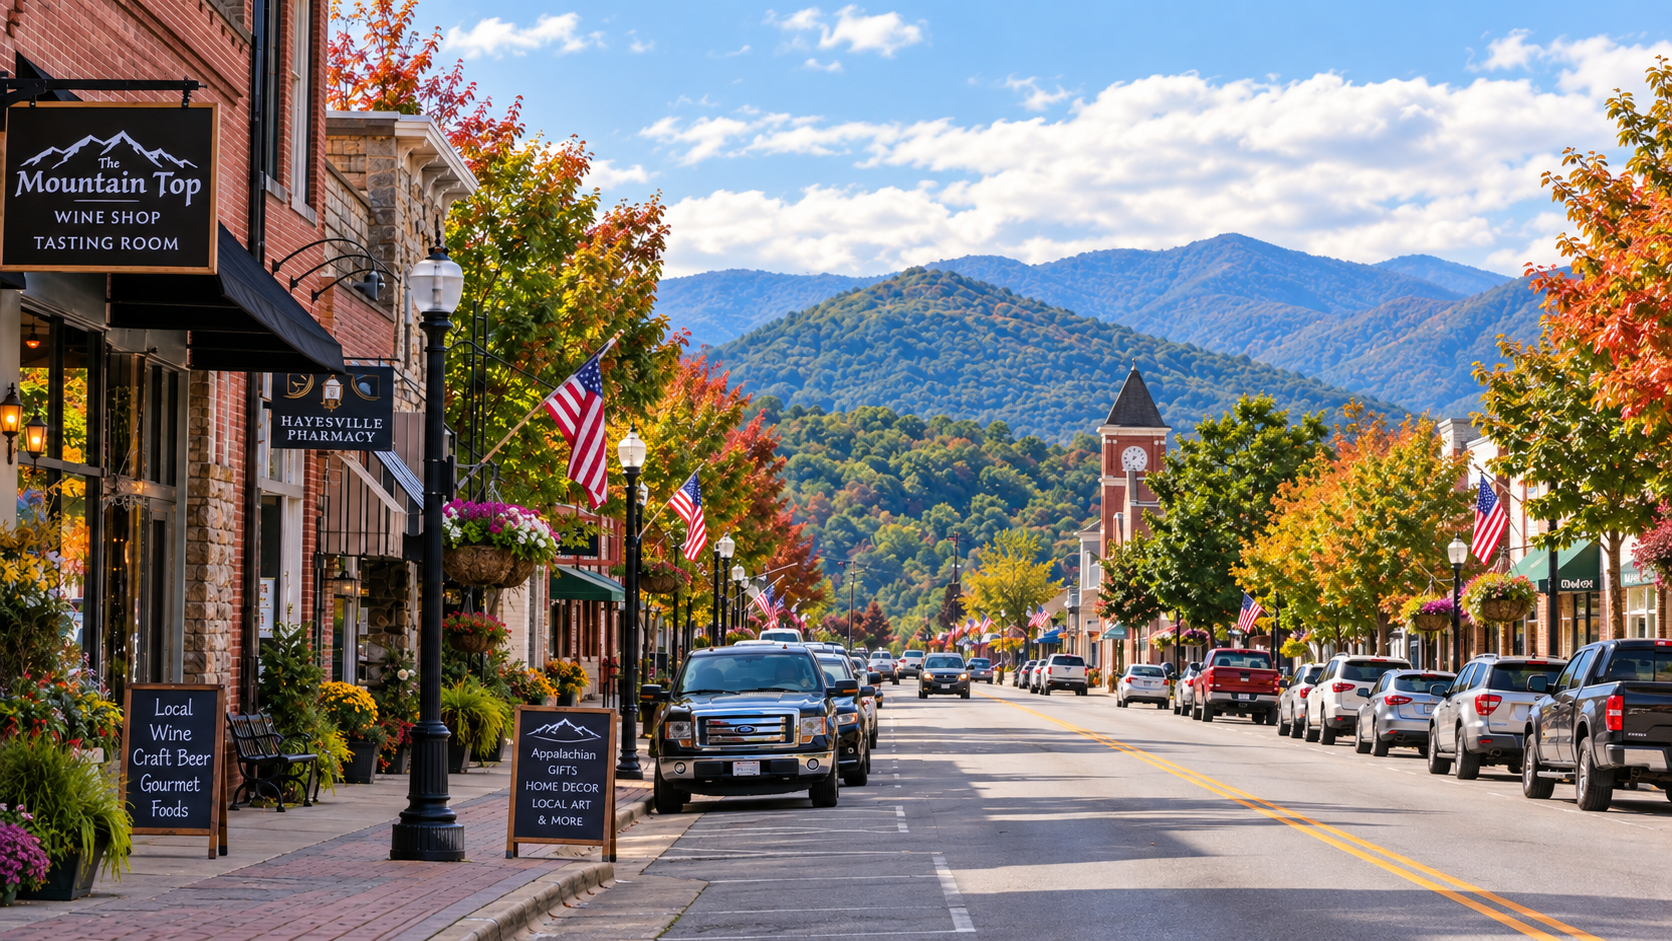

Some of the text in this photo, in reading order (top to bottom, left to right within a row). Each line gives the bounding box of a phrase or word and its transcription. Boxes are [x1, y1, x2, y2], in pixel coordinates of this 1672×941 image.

[98, 156, 120, 169] The
[15, 170, 201, 207] Mountain Top
[54, 210, 161, 225] WINE SHOP
[33, 236, 179, 250] TASTING ROOM
[281, 415, 383, 429] HAYESVILLE
[287, 429, 376, 443] PHARMACY
[154, 697, 194, 717] Local
[149, 723, 192, 742] Wine
[132, 748, 212, 767] Craft Beer
[530, 747, 597, 762] Appalachian
[547, 764, 578, 776] GIFTS
[140, 773, 201, 794] Gourmet
[525, 780, 599, 793] HOME DECOR
[151, 799, 189, 818] Foods
[532, 798, 591, 810] LOCAL ART
[537, 815, 584, 826] & MORE
